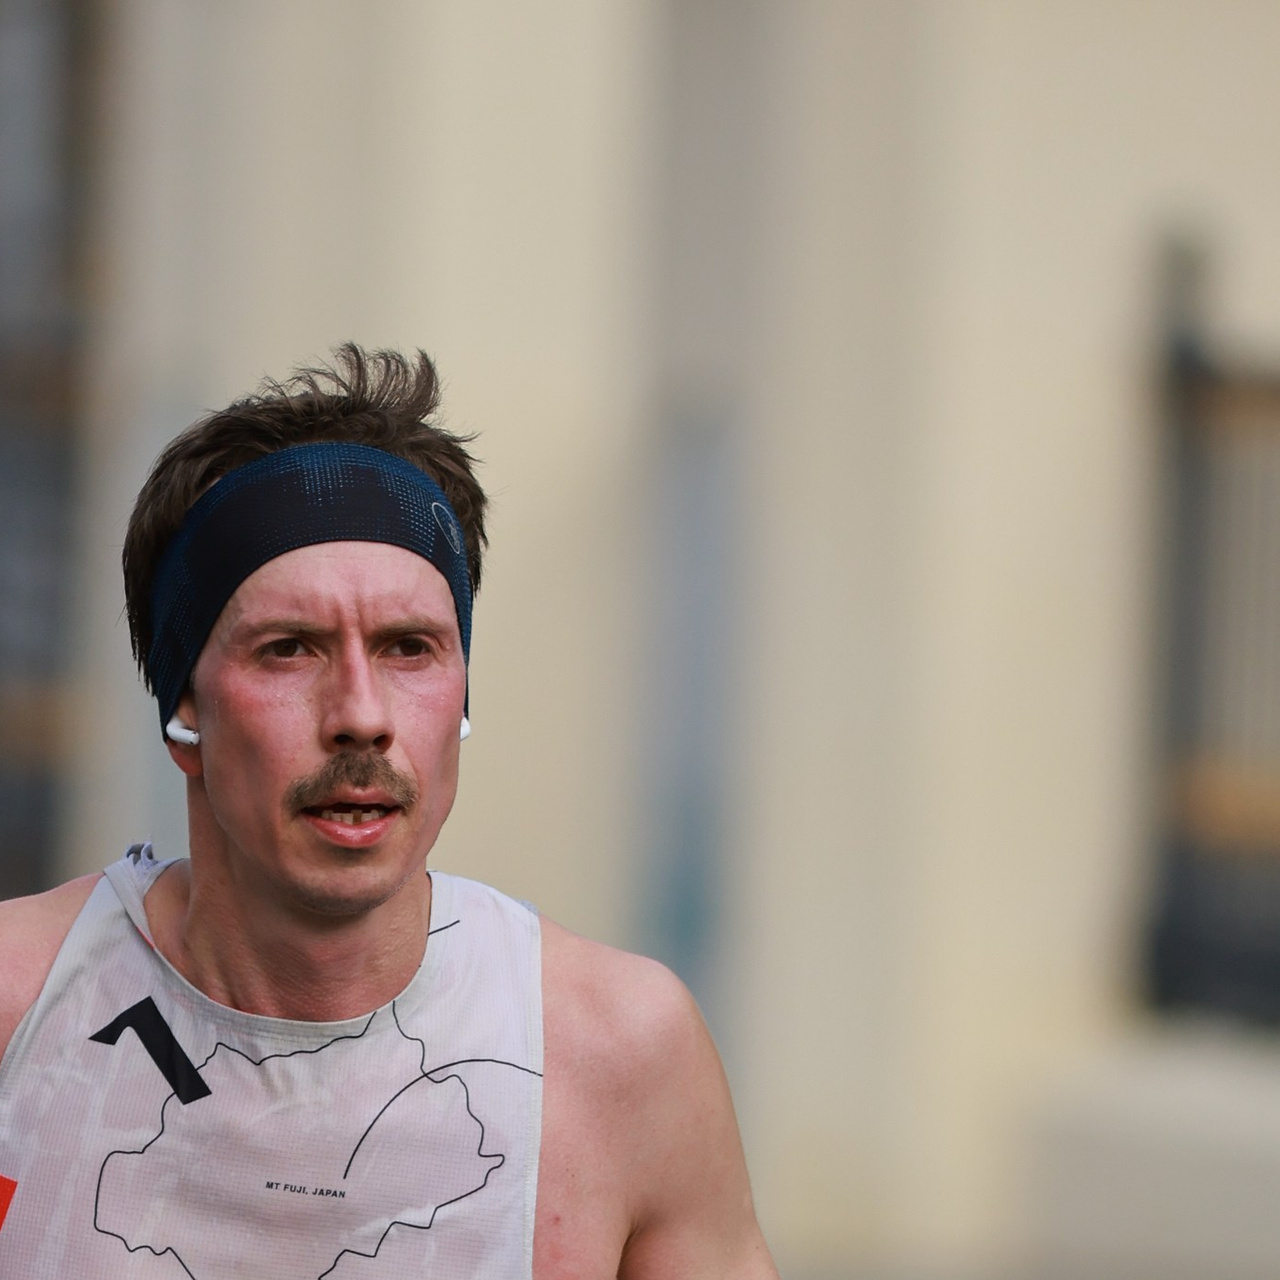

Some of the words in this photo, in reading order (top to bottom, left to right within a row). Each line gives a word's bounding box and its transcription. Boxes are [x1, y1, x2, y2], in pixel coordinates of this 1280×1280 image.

[266, 1181, 280, 1190] MT
[283, 1184, 308, 1195] FUJI,
[312, 1188, 346, 1198] JAPAN
